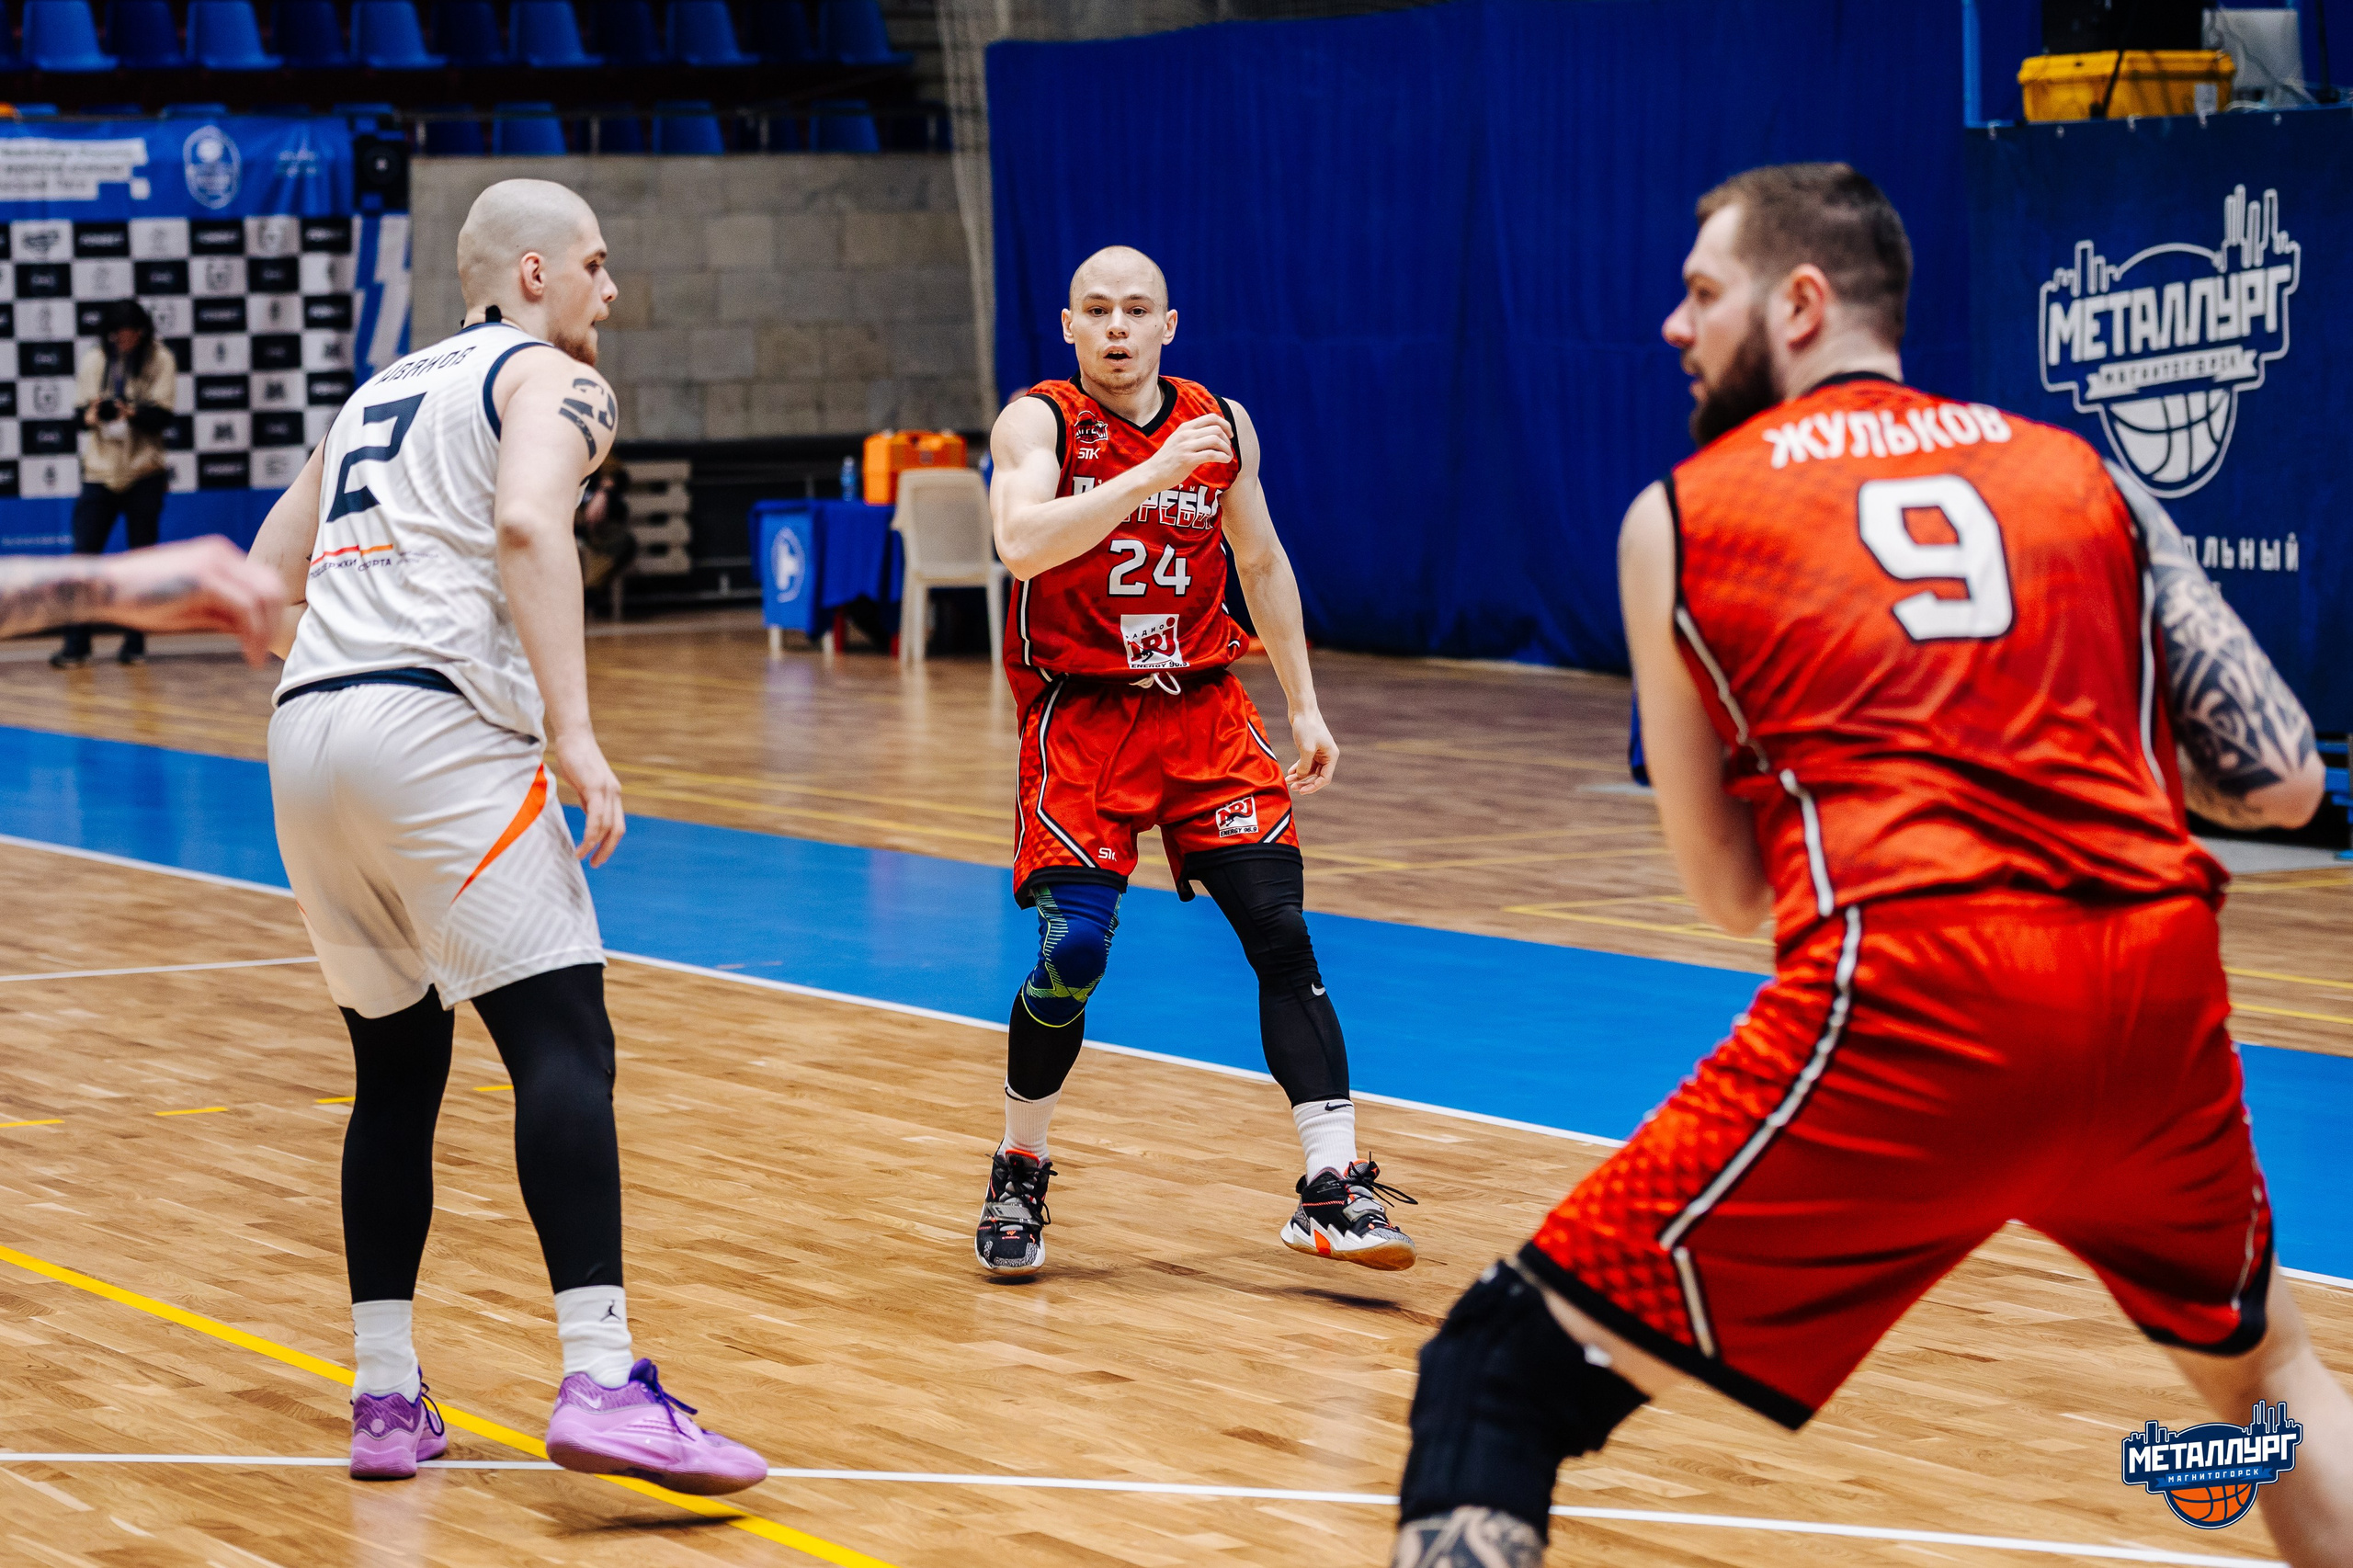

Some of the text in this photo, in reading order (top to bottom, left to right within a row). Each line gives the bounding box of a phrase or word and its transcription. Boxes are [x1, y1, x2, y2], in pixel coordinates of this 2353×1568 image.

[2047, 264, 2292, 366] МЕТАЛЛУРГ
[325, 391, 428, 524] 2
[1077, 447, 1101, 460] STK
[1761, 402, 2012, 470] ЖУЛЬКОВ
[358, 557, 392, 572] СОРТА
[1107, 539, 1192, 597] 24
[1858, 473, 2014, 641] 9
[1220, 827, 1243, 837] ENERGY
